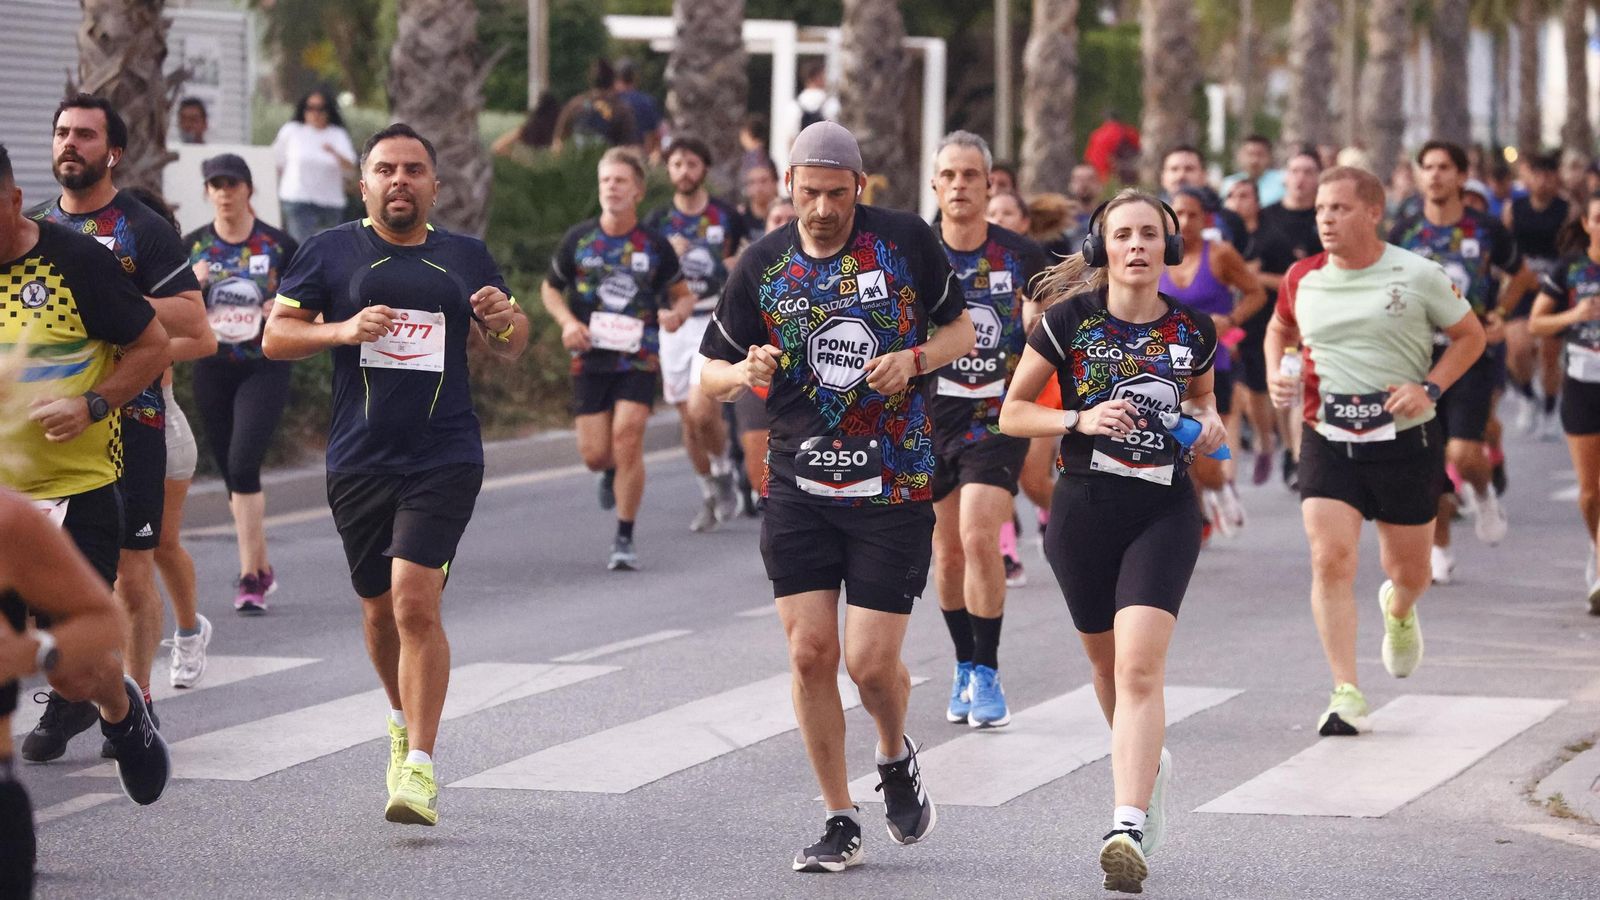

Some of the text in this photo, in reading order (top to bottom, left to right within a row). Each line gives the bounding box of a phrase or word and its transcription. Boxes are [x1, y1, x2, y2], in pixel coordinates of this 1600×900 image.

[862, 285, 883, 298] AXA
[382, 322, 433, 339] 777
[972, 321, 994, 335] NLE
[817, 338, 869, 355] PONLE
[817, 352, 865, 369] FRENO
[952, 357, 997, 371] 1006
[1122, 390, 1172, 414] PONLE
[1333, 403, 1382, 418] 2859
[1110, 429, 1165, 450] 623
[807, 450, 868, 467] 2950
